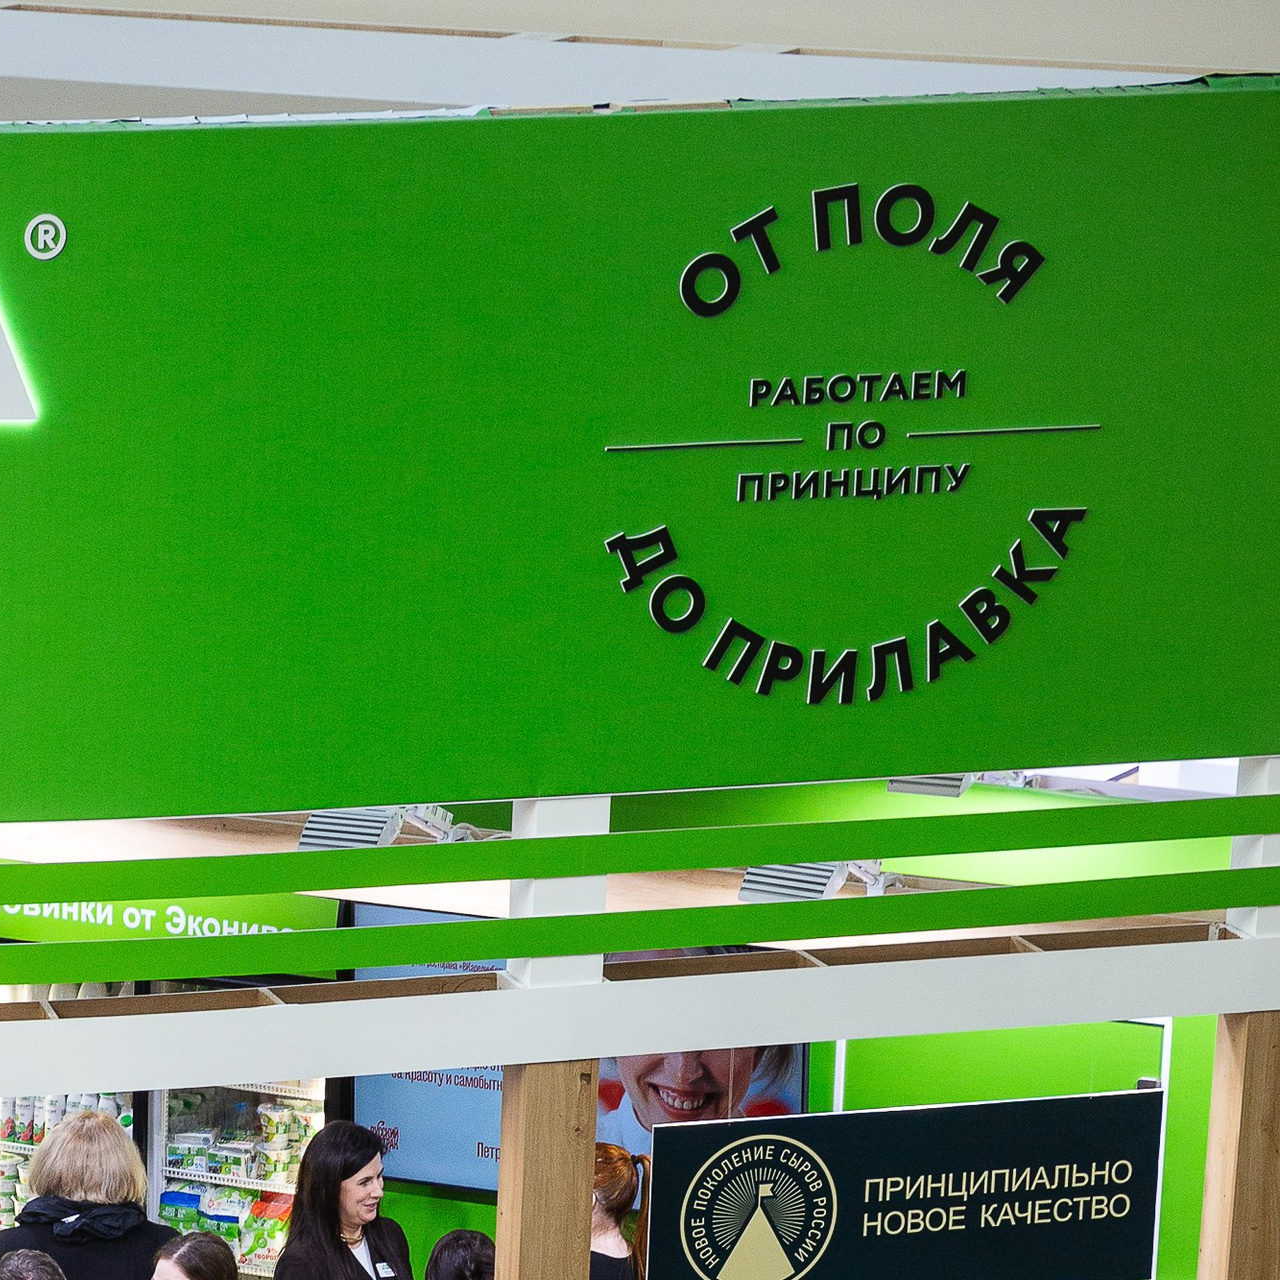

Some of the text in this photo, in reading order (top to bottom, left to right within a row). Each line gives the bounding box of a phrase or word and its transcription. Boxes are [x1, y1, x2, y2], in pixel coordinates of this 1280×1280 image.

[679, 182, 1046, 318] ОТ ПОЛЯ
[749, 369, 967, 407] РАБОТАЕМ
[826, 420, 886, 451] ПО
[737, 463, 971, 502] ПРИНЦИПУ
[604, 506, 1088, 705] ДО ПРИЛАВКА
[123, 907, 156, 931] от
[446, 1074, 452, 1085] и
[864, 1159, 1134, 1202] ПРИНЦИПИАЛЬНО
[691, 1144, 828, 1270] НОВОЕ ПОКОЛЕНИЕ СЫРОВ РОССИИ
[862, 1193, 1132, 1237] НОВОЕ КАЧЕСТВО
